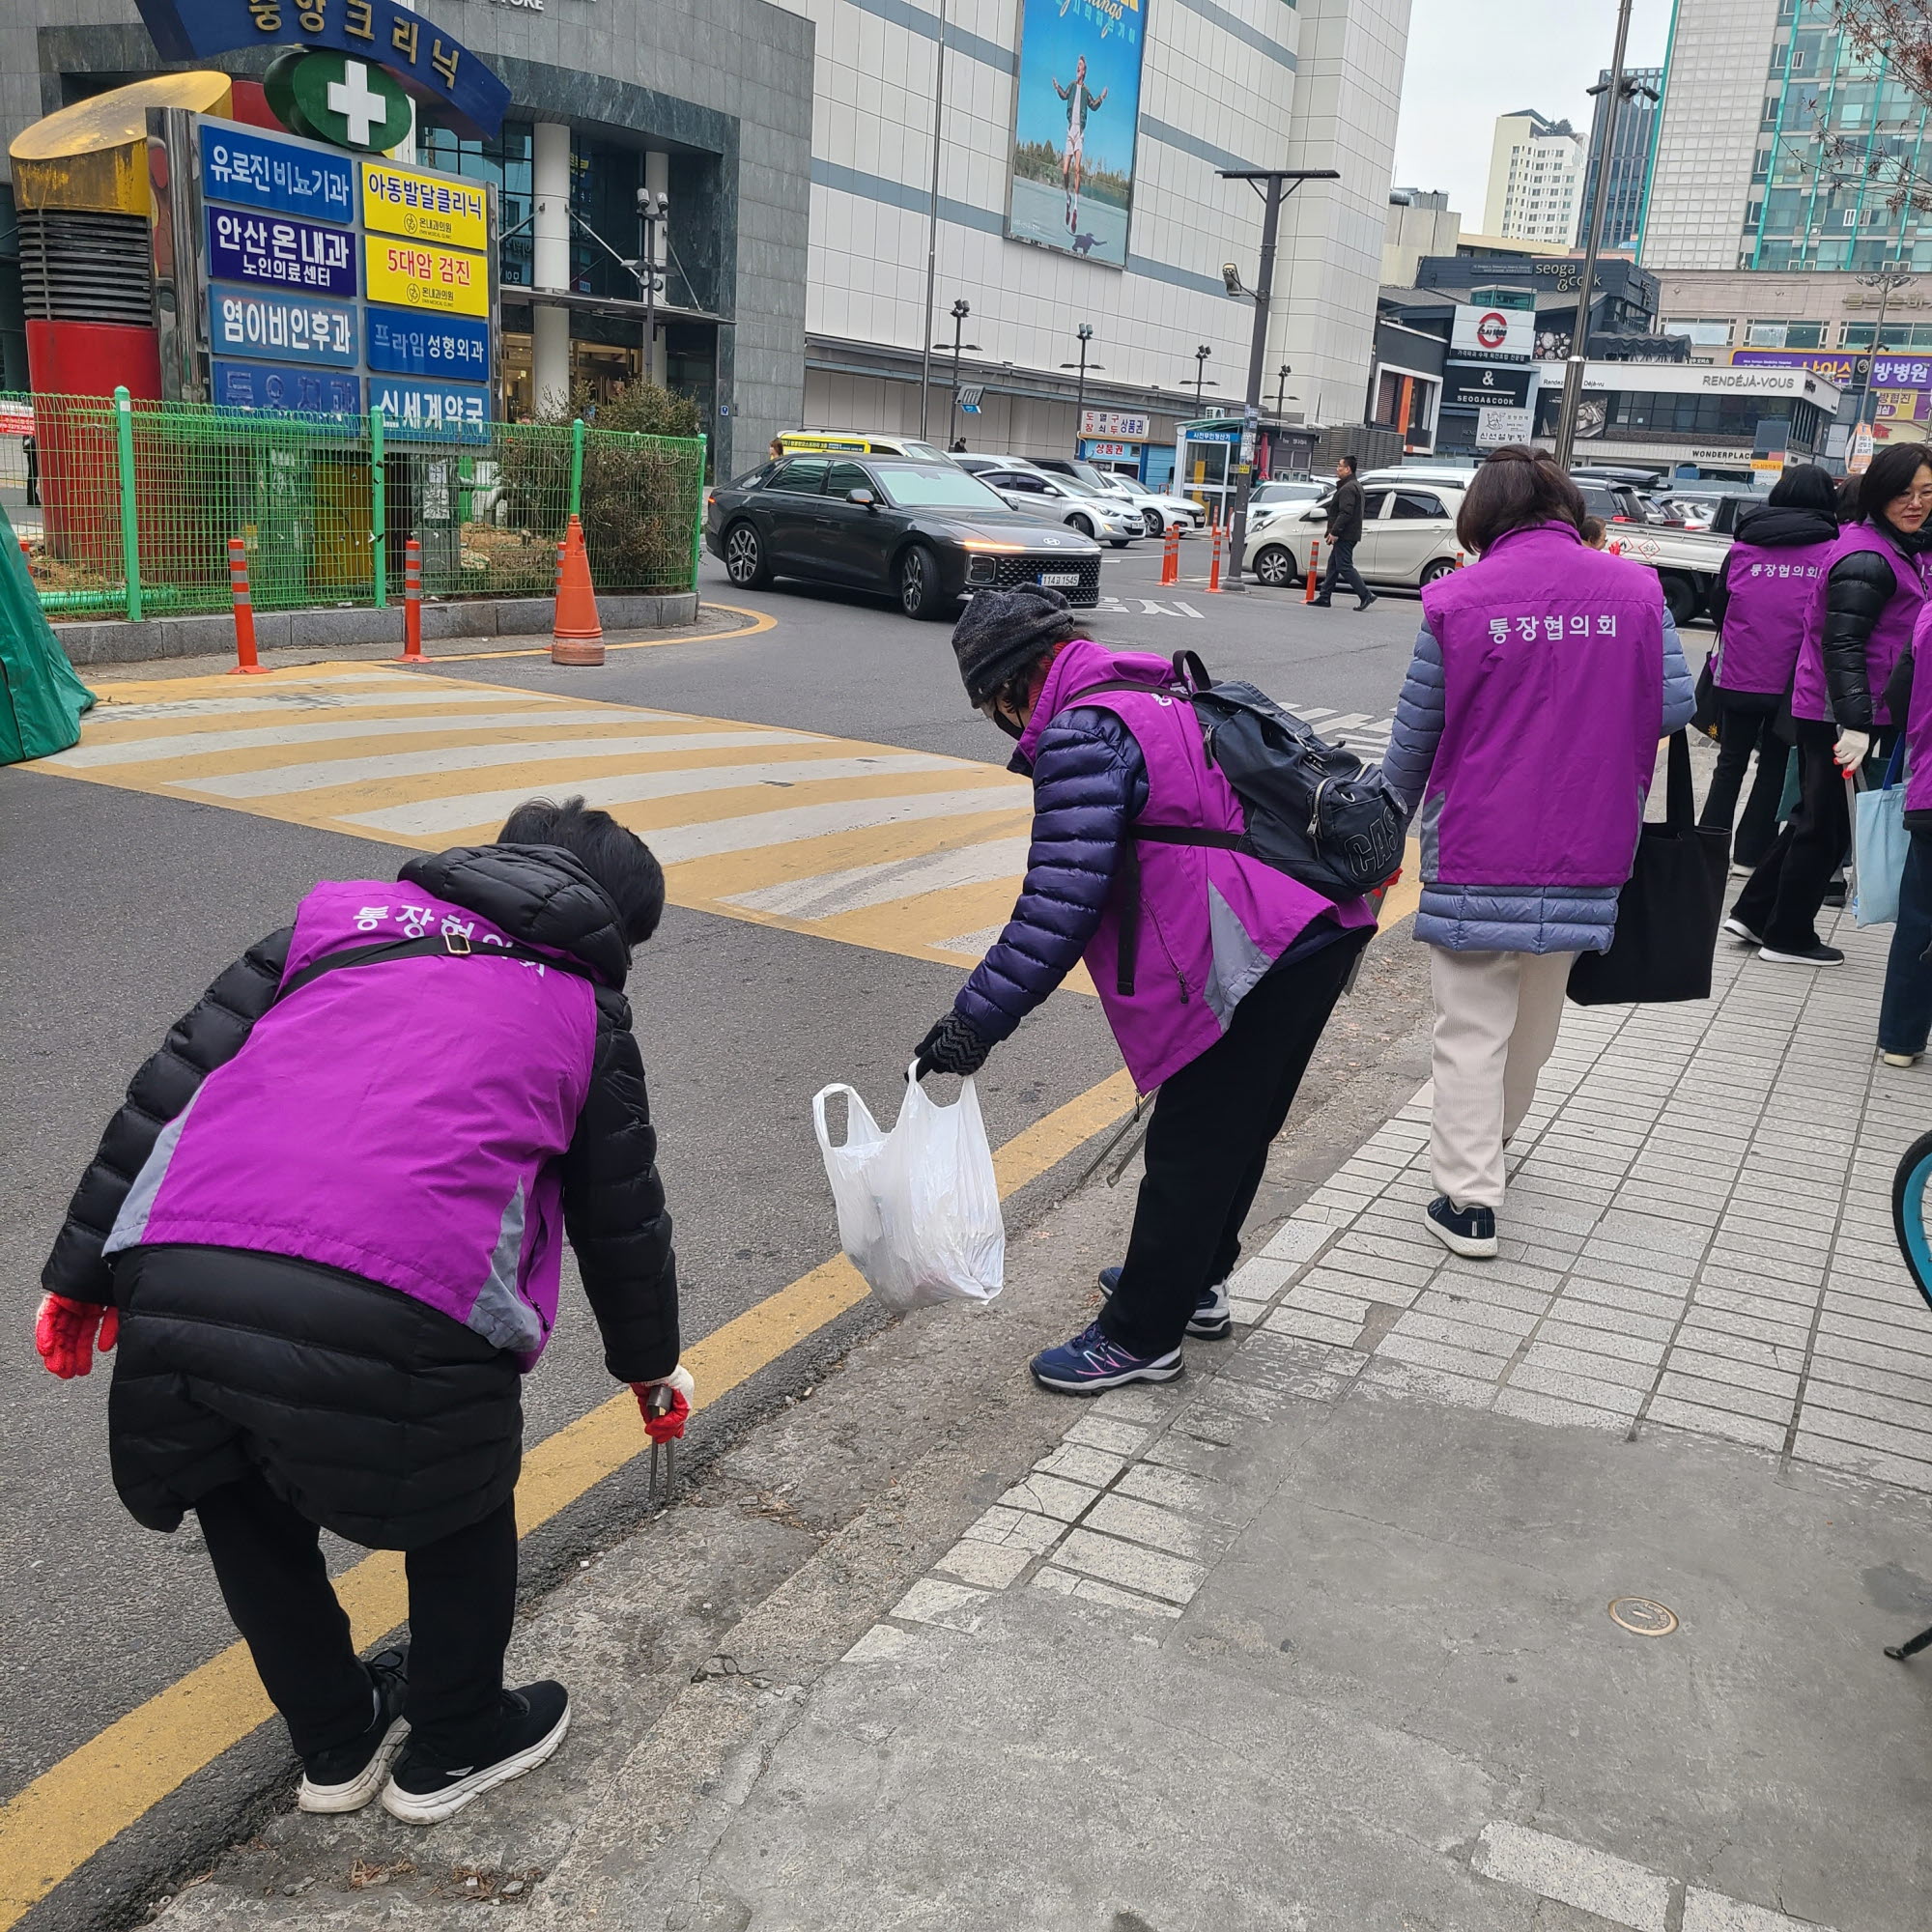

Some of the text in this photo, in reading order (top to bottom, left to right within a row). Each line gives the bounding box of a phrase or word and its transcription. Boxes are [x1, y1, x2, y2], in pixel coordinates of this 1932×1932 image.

[368, 173, 482, 220] 아동발달클리닉
[418, 217, 452, 234] 온내과의원
[242, 254, 330, 287] 노인의료센터
[387, 248, 471, 286] 5대암 검진
[1535, 263, 1576, 277] seoga
[422, 287, 454, 301] 온내과의원
[222, 298, 351, 355] 염이비인후과
[1482, 370, 1494, 386] &
[1702, 373, 1795, 388] RENDÉJÀ-VOUS
[1457, 394, 1515, 406] SEOGA&COOK
[380, 389, 484, 434] 신세계약국
[1121, 418, 1144, 435] 상품권
[1095, 443, 1123, 455] 상품권
[1691, 449, 1753, 461] WONDERPLAC
[1749, 563, 1819, 579] 통장협의회
[1062, 575, 1079, 585] 1545
[1488, 614, 1617, 645] 통장협의회
